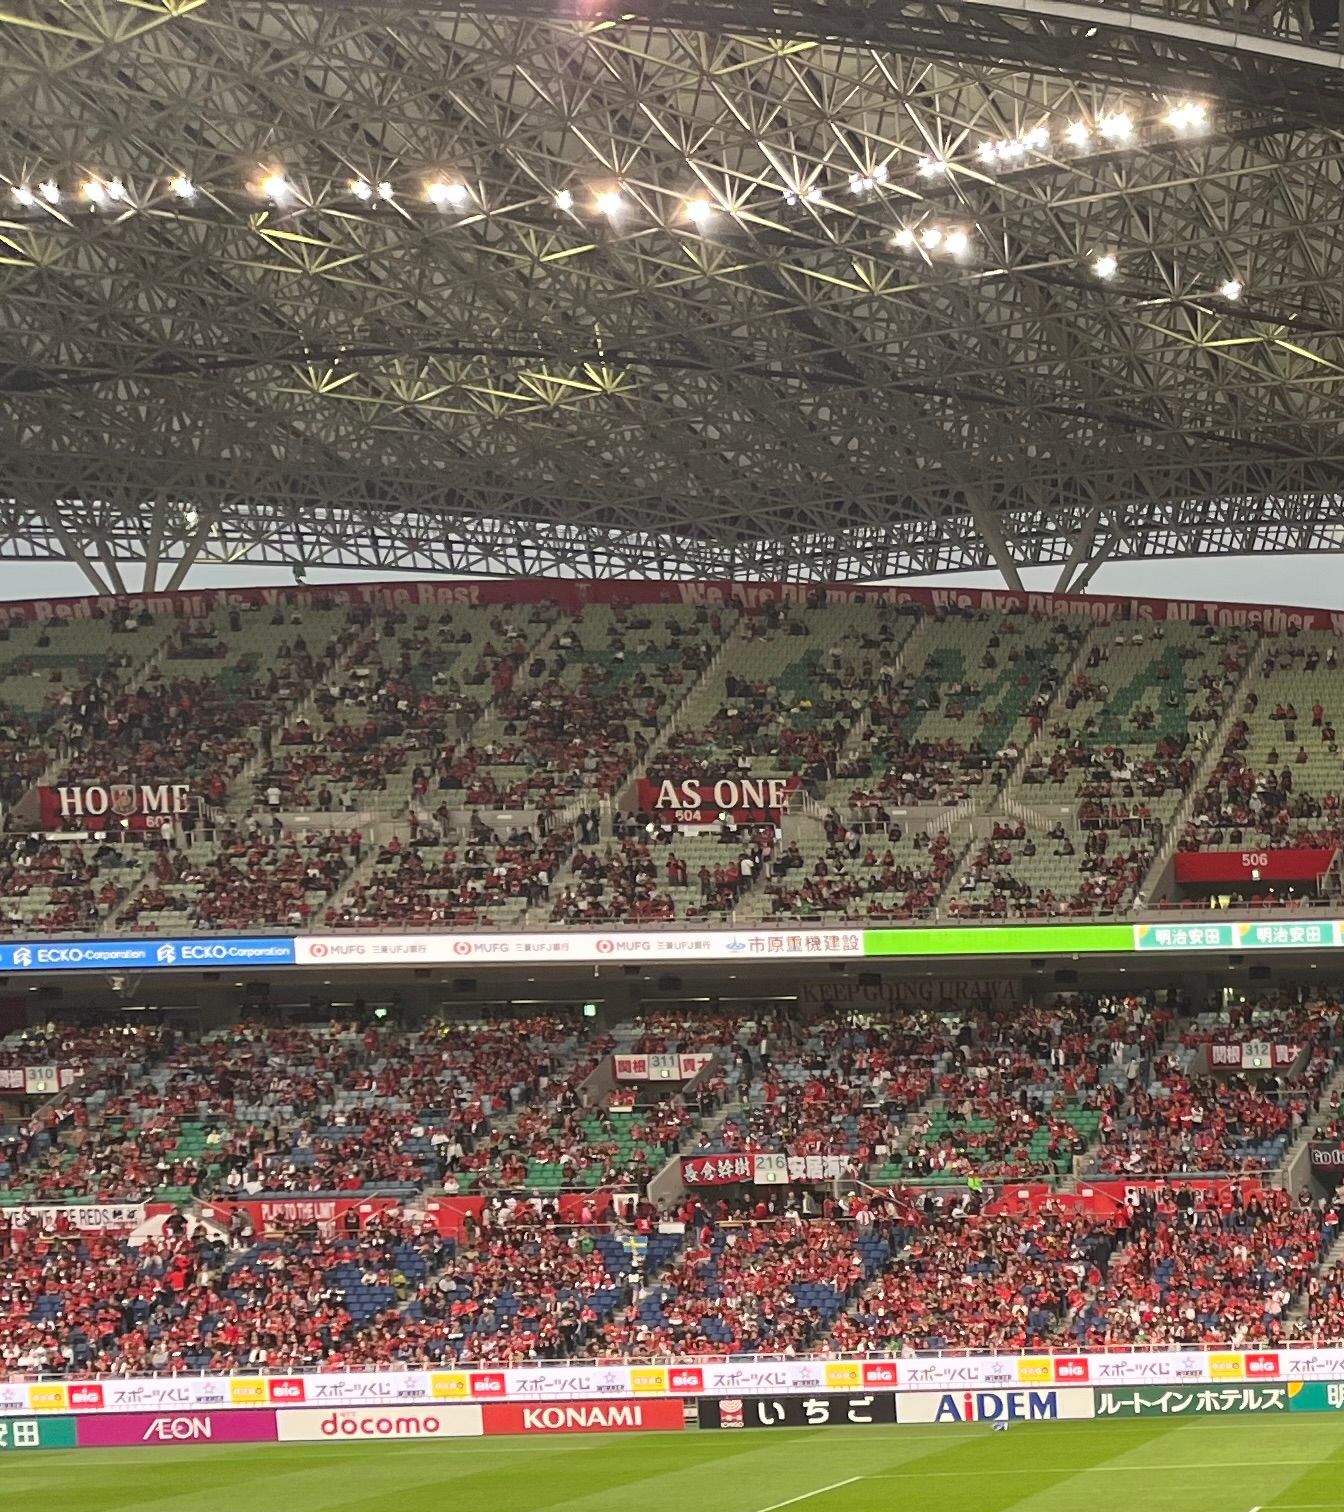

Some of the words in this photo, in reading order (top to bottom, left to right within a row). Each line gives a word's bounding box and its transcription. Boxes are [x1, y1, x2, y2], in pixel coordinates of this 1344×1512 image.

[655, 779, 702, 809] AS
[714, 779, 788, 809] ONE
[1242, 853, 1267, 867] 506
[1156, 929, 1220, 945] 明治安田
[1257, 926, 1321, 943] 明治安田
[331, 944, 365, 955] MUFG
[475, 942, 509, 953] MUFG
[617, 941, 650, 951] MUFG
[748, 934, 860, 953] 市原重機建設
[1244, 1043, 1270, 1057] 312
[651, 1055, 677, 1068] 311
[28, 1068, 54, 1080] 310
[756, 1154, 786, 1171] 216
[907, 1365, 979, 1382] スポーツくじ
[1099, 1360, 1170, 1377] スポーツくじ
[515, 1374, 590, 1392] スポーツくじ
[713, 1370, 787, 1388] スポーツくじ
[114, 1386, 189, 1404] スポーツくじ
[315, 1381, 391, 1399] スポーツくじ
[1098, 1387, 1286, 1414] ルートインホテルズ
[523, 1404, 642, 1429] KONAMI
[758, 1397, 875, 1425] いちご
[321, 1410, 440, 1434] docomo
